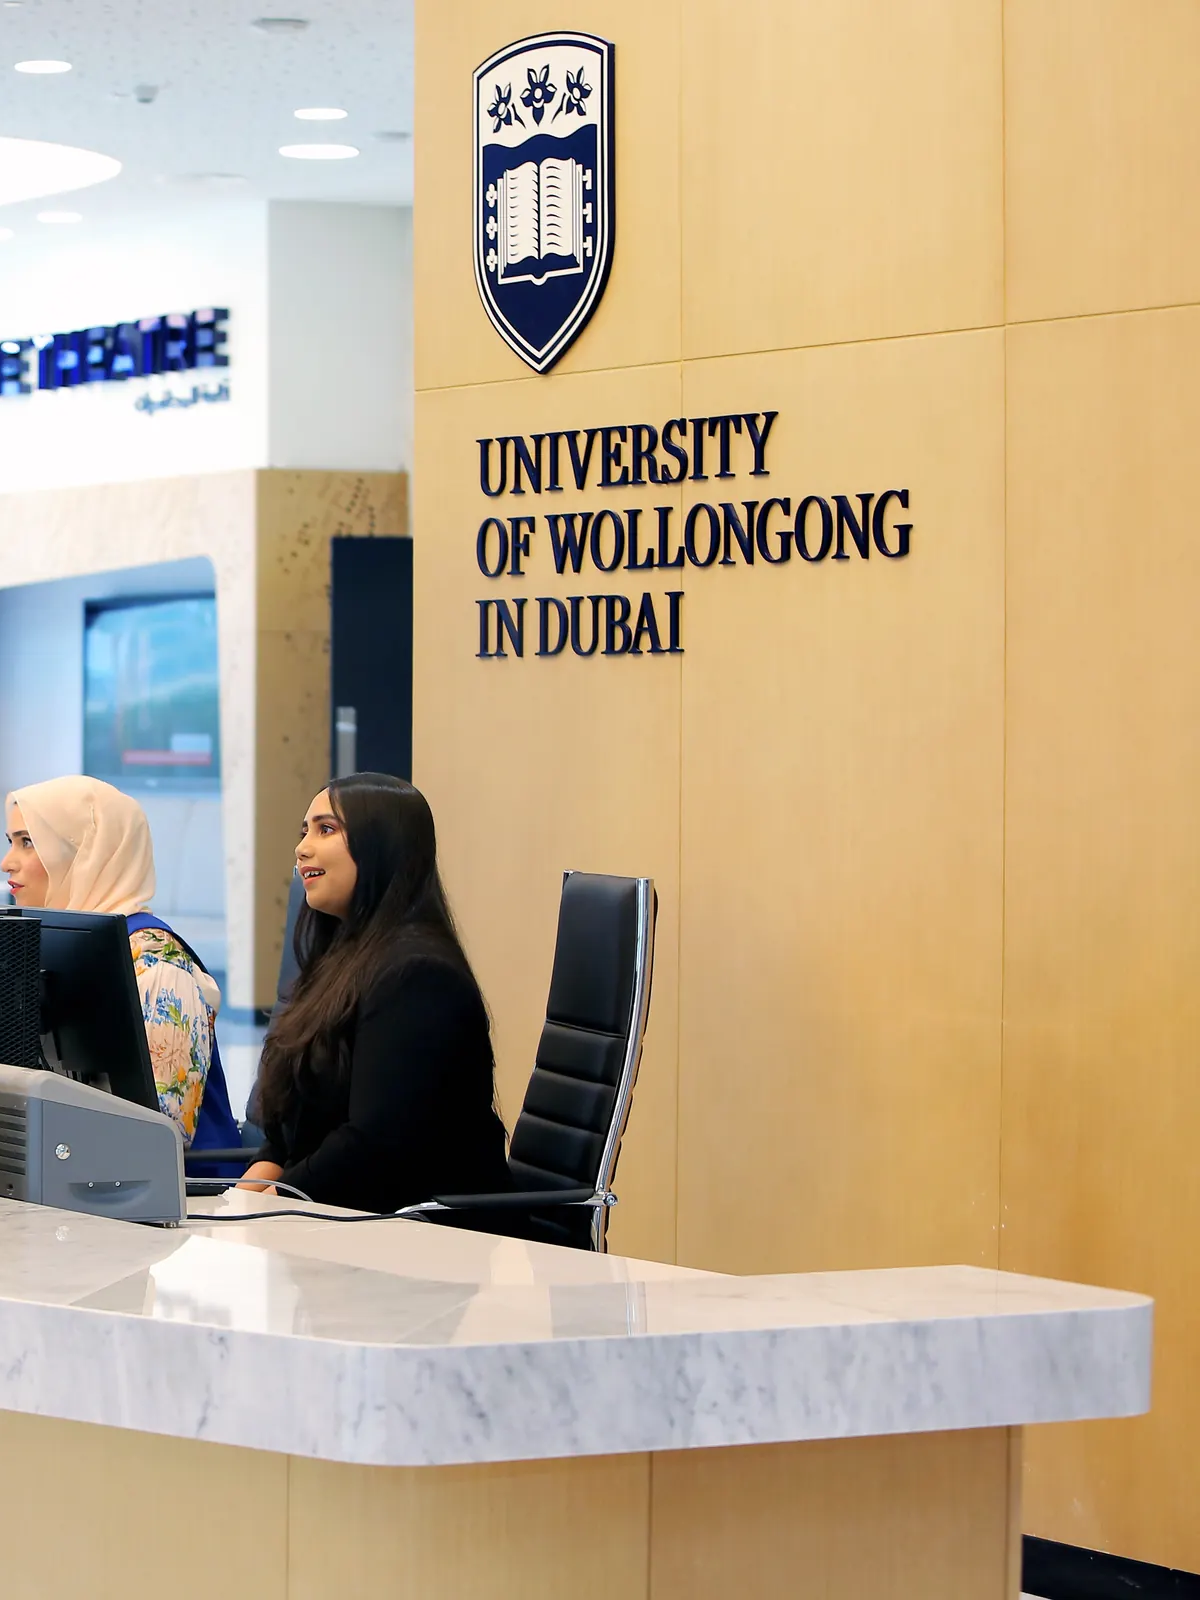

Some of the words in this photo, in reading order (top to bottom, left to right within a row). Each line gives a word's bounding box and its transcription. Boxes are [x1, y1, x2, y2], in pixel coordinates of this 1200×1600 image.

[475, 410, 779, 498] UNIVERSITY
[476, 516, 535, 578] OF
[544, 488, 913, 575] WOLLONGONG
[475, 597, 528, 659] IN
[535, 590, 685, 659] DUBAI
